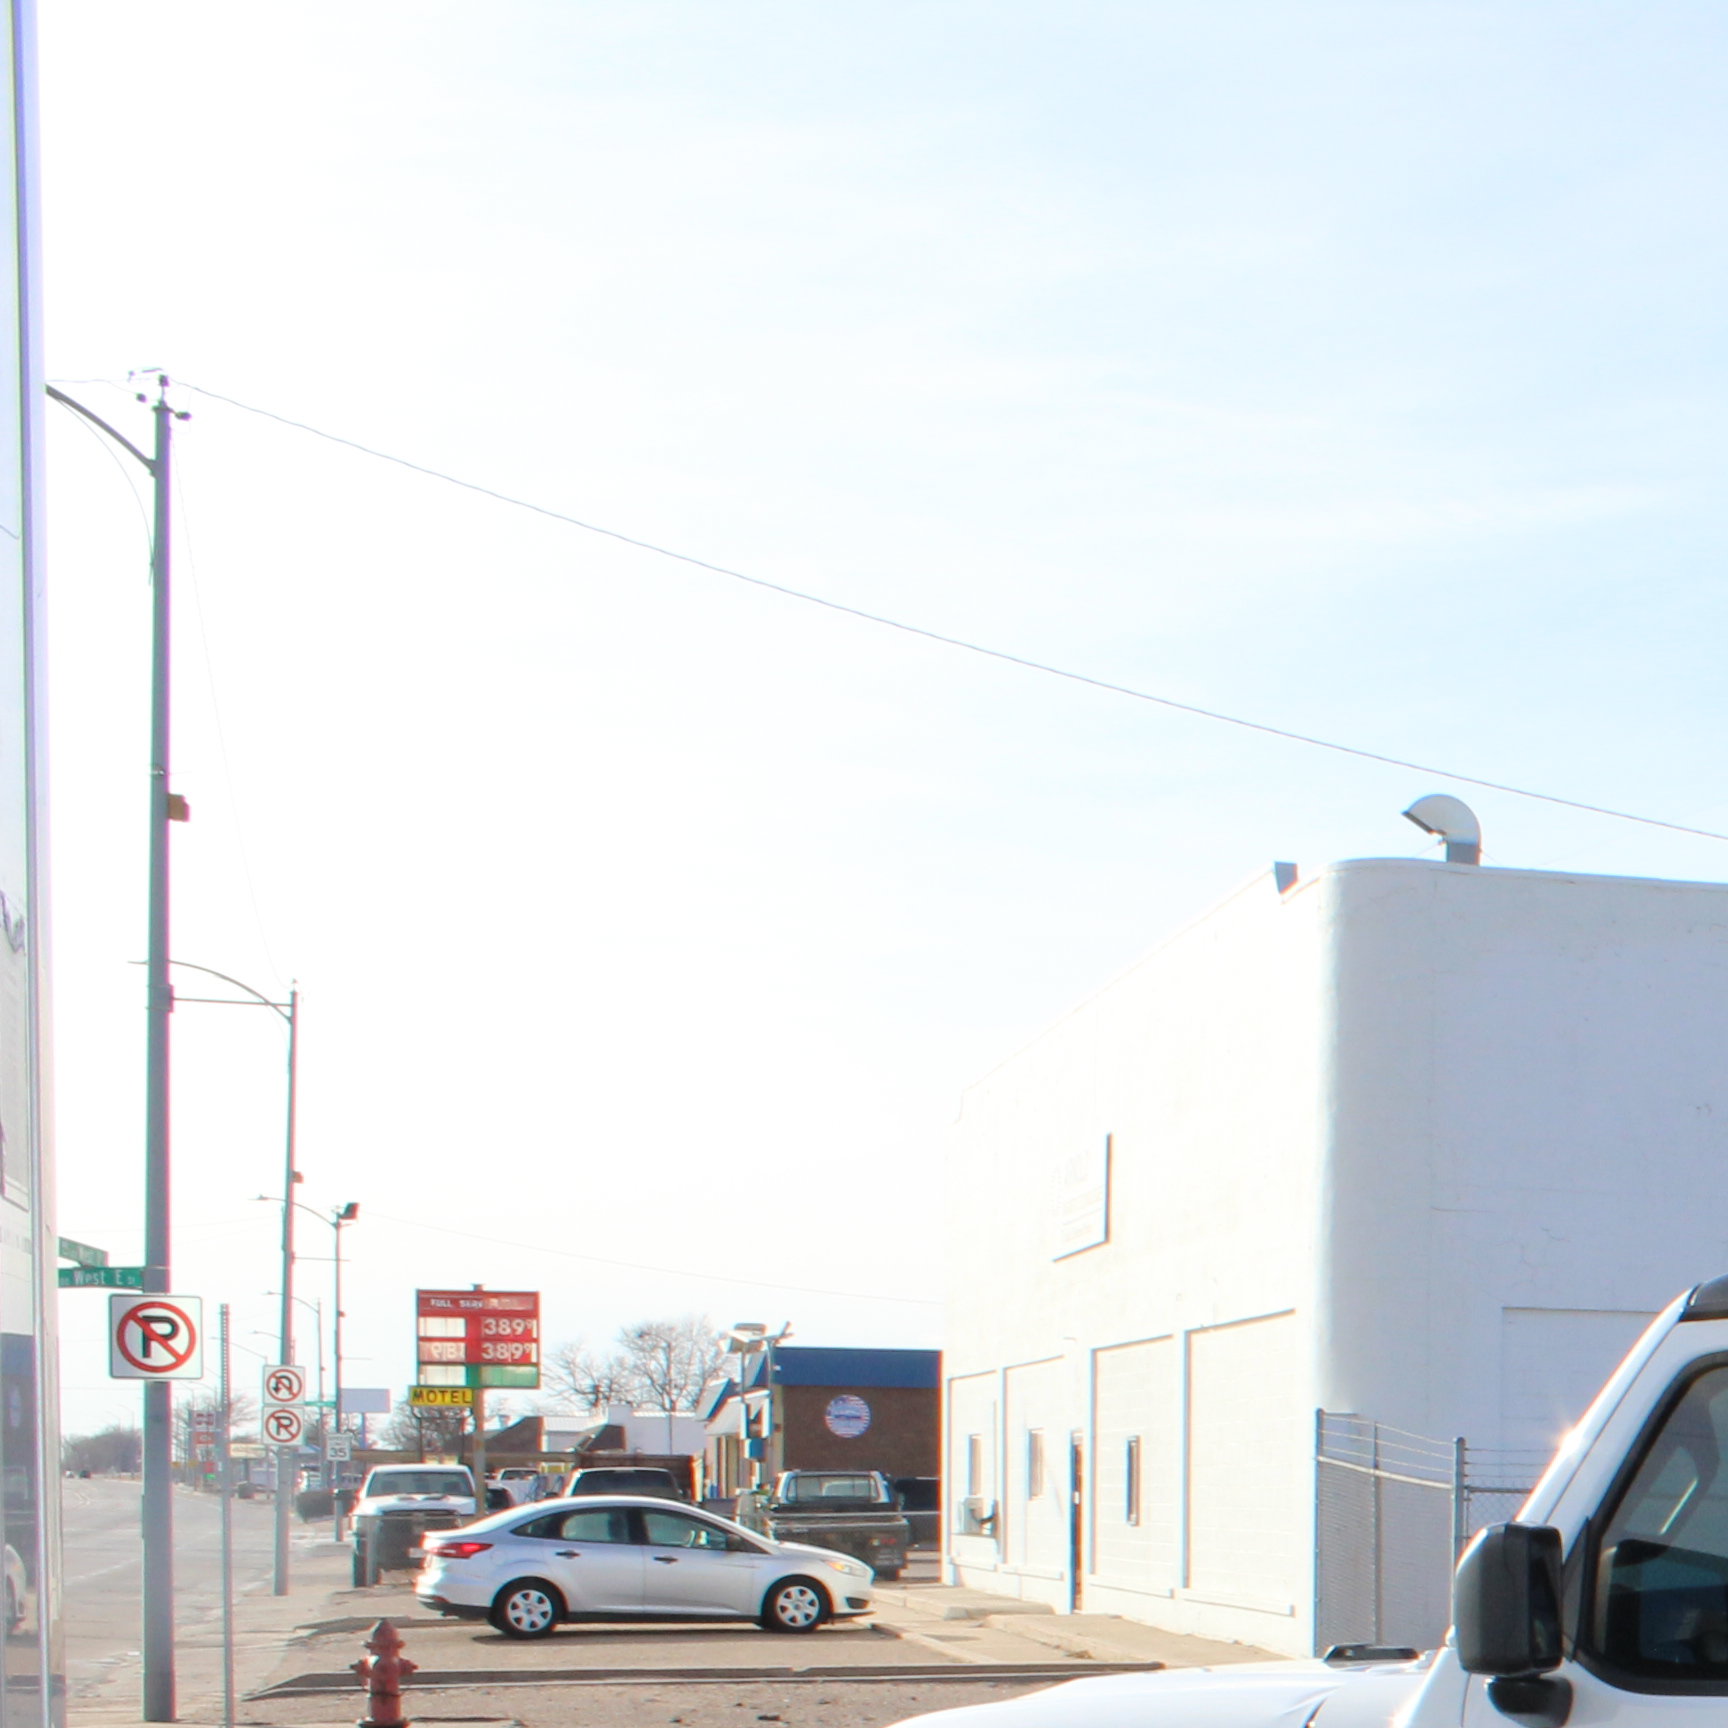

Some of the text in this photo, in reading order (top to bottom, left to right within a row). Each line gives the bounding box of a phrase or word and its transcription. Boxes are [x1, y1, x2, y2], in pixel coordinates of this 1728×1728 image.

[73, 1269, 105, 1286] West
[115, 1269, 123, 1285] E
[412, 1389, 472, 1404] MOTEL
[330, 1447, 347, 1458] 35
